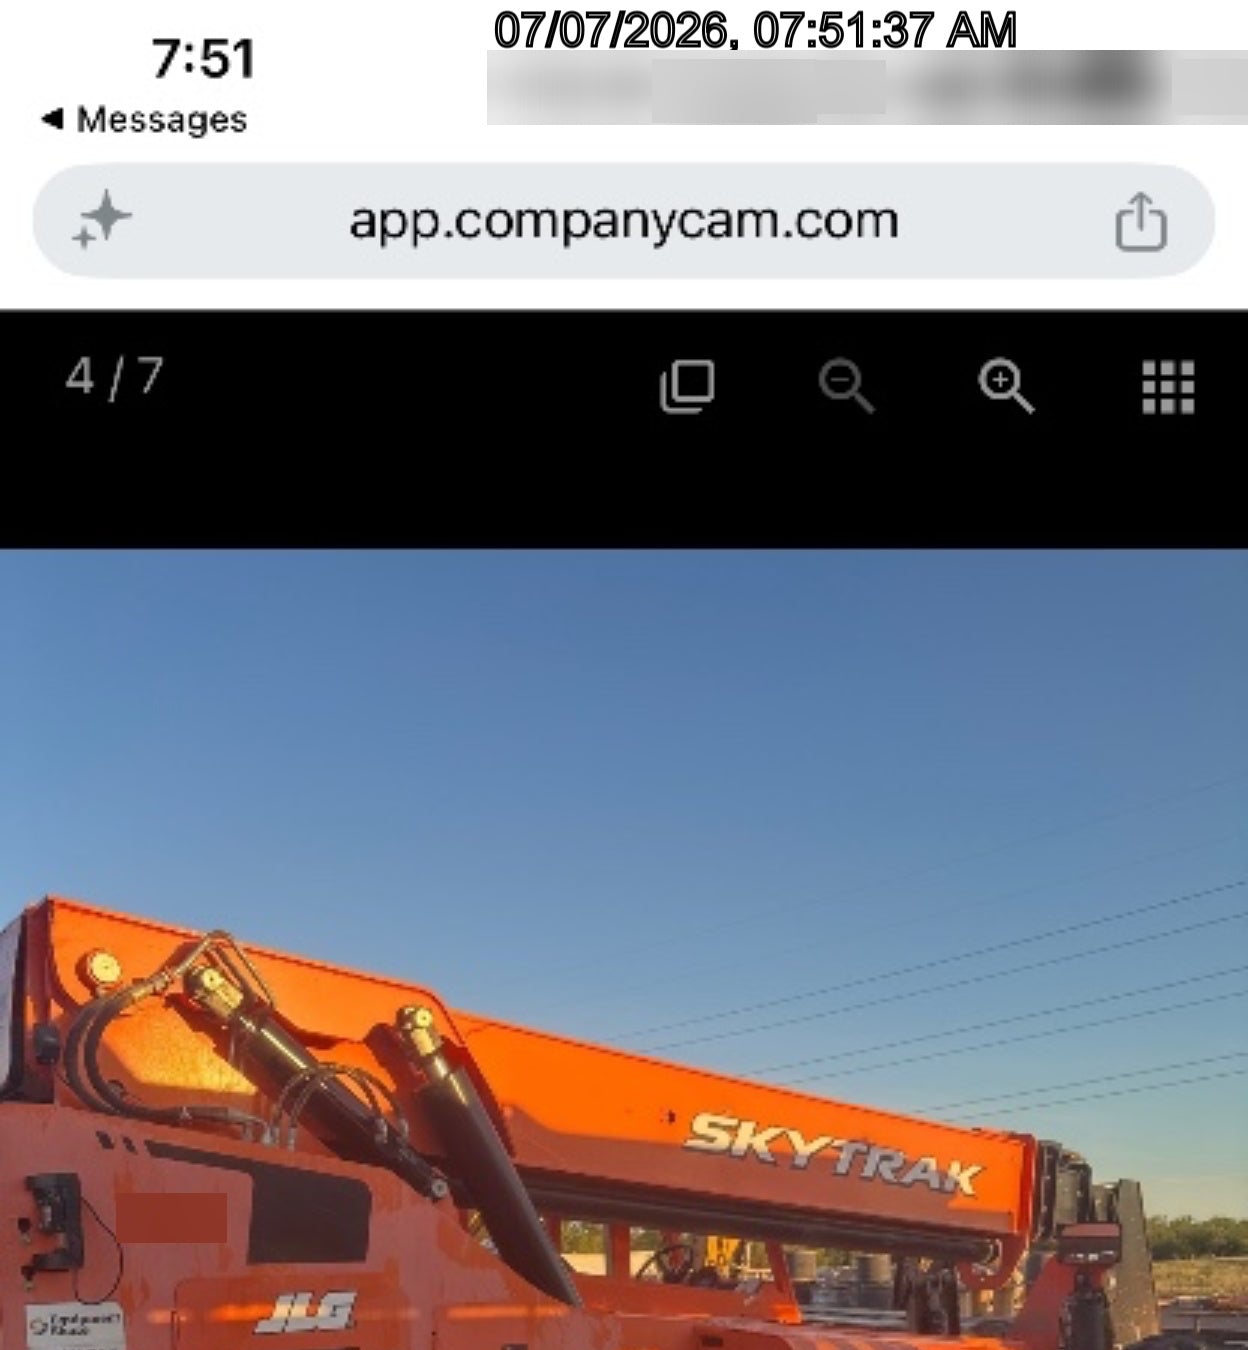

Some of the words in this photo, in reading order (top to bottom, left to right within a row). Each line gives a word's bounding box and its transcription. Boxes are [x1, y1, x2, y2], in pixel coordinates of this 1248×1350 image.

[151, 38, 252, 79] 7:51
[78, 105, 247, 138] Messages
[350, 208, 898, 249] app.companycam.com
[65, 355, 94, 395] 4
[137, 355, 163, 395] 7
[683, 1112, 984, 1197] SKYTRAK
[253, 1291, 358, 1334] JLG
